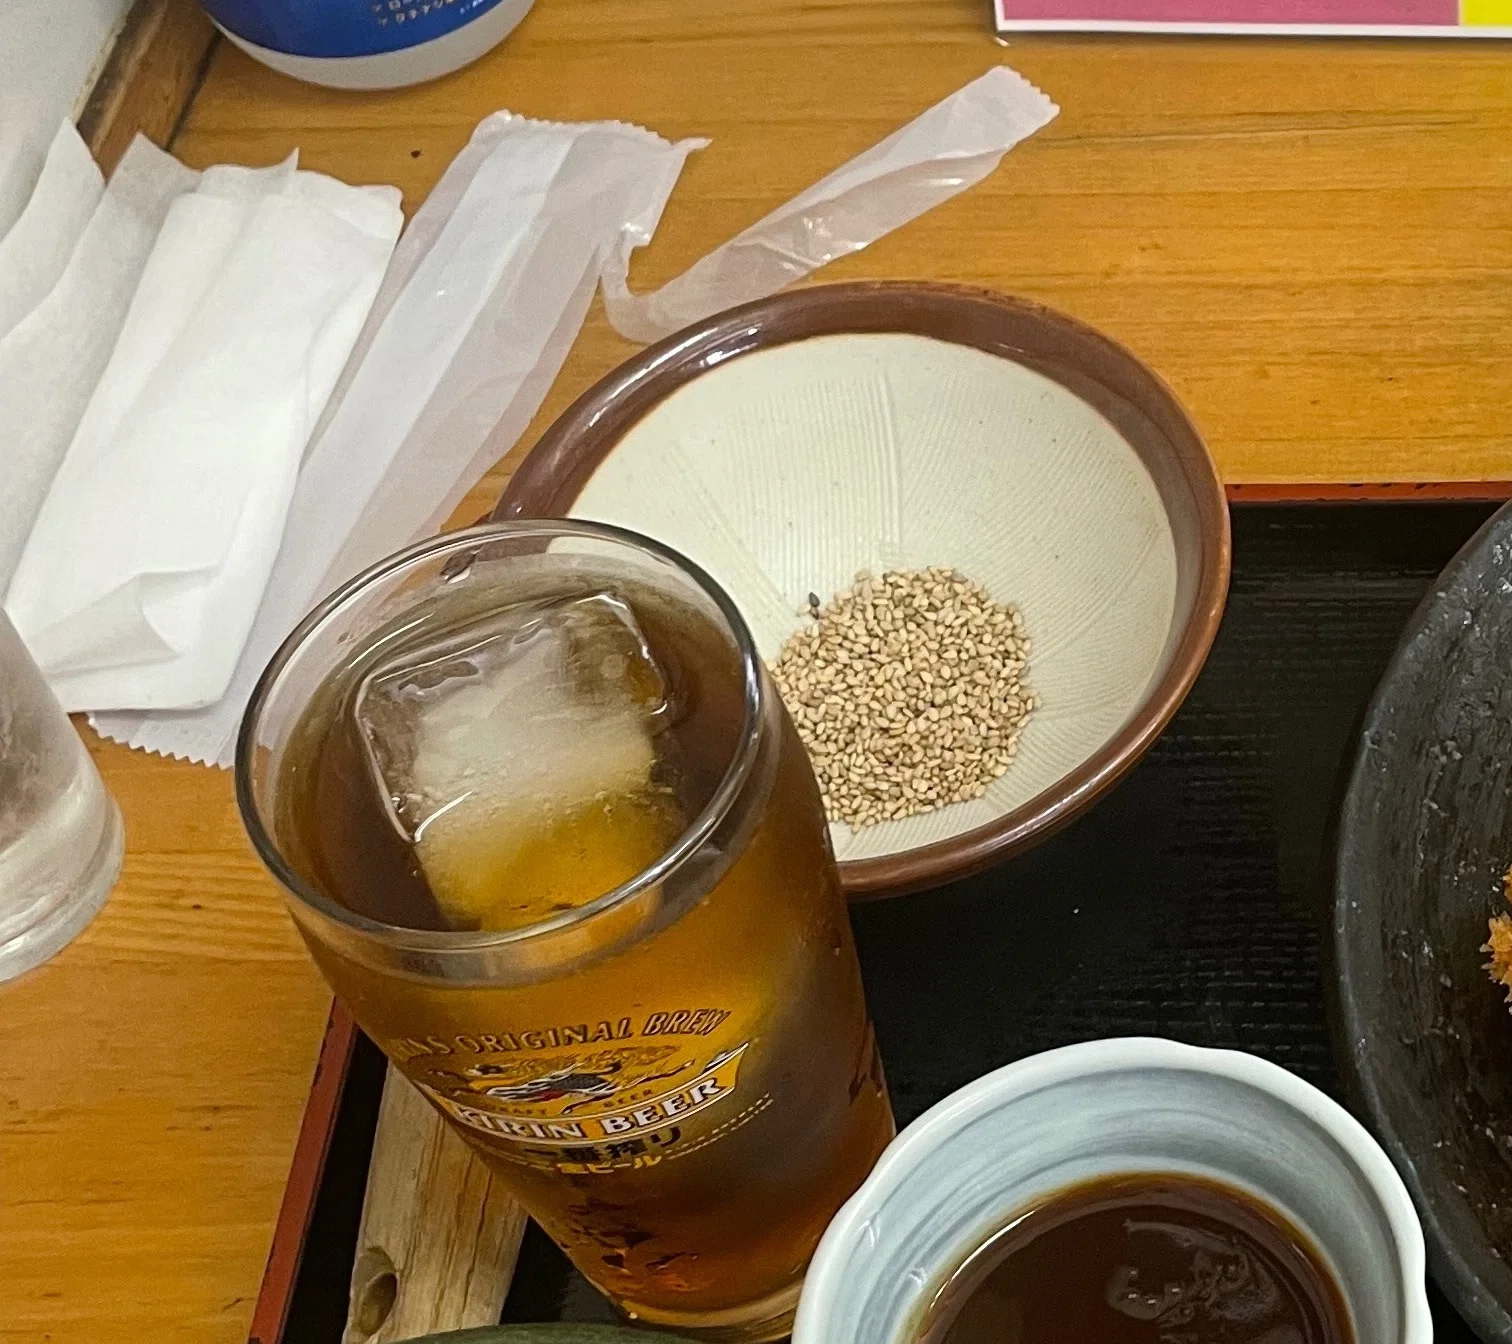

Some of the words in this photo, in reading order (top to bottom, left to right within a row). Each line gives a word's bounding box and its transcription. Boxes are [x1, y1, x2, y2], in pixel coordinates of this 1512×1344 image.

[455, 1017, 633, 1055] ORIGINAL
[643, 1009, 734, 1037] BREW
[457, 1104, 587, 1139] KIRIN
[602, 1077, 726, 1135] BEER
